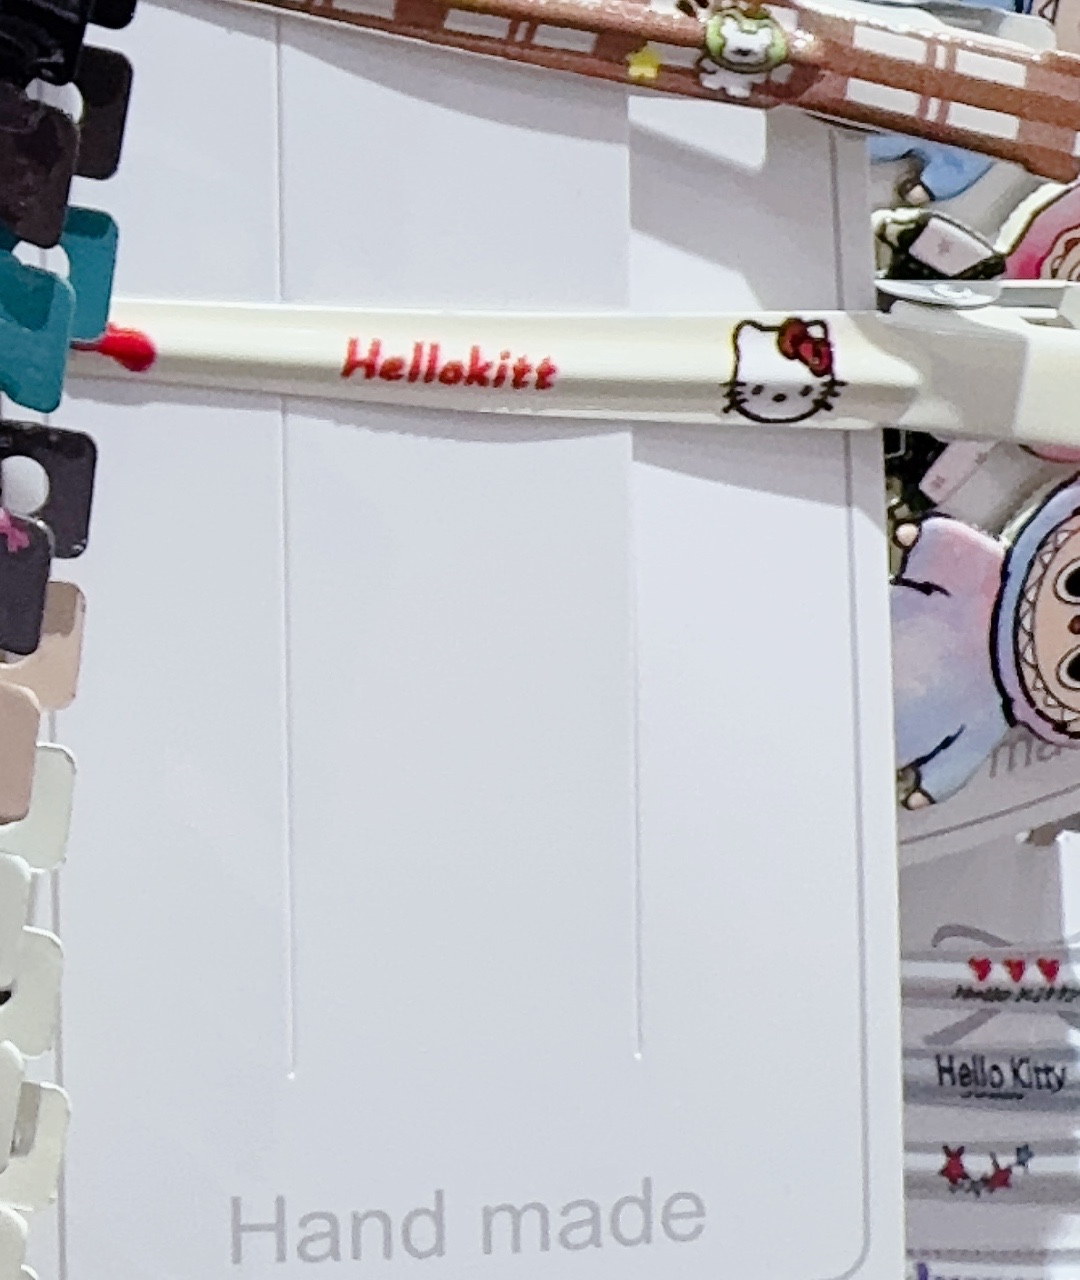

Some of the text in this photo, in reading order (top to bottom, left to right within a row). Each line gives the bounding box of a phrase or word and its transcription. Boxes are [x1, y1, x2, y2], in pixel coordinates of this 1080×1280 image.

[340, 337, 558, 391] Hellokitt
[935, 1052, 1068, 1095] Hello Kitty
[230, 1175, 708, 1266] Hand made
